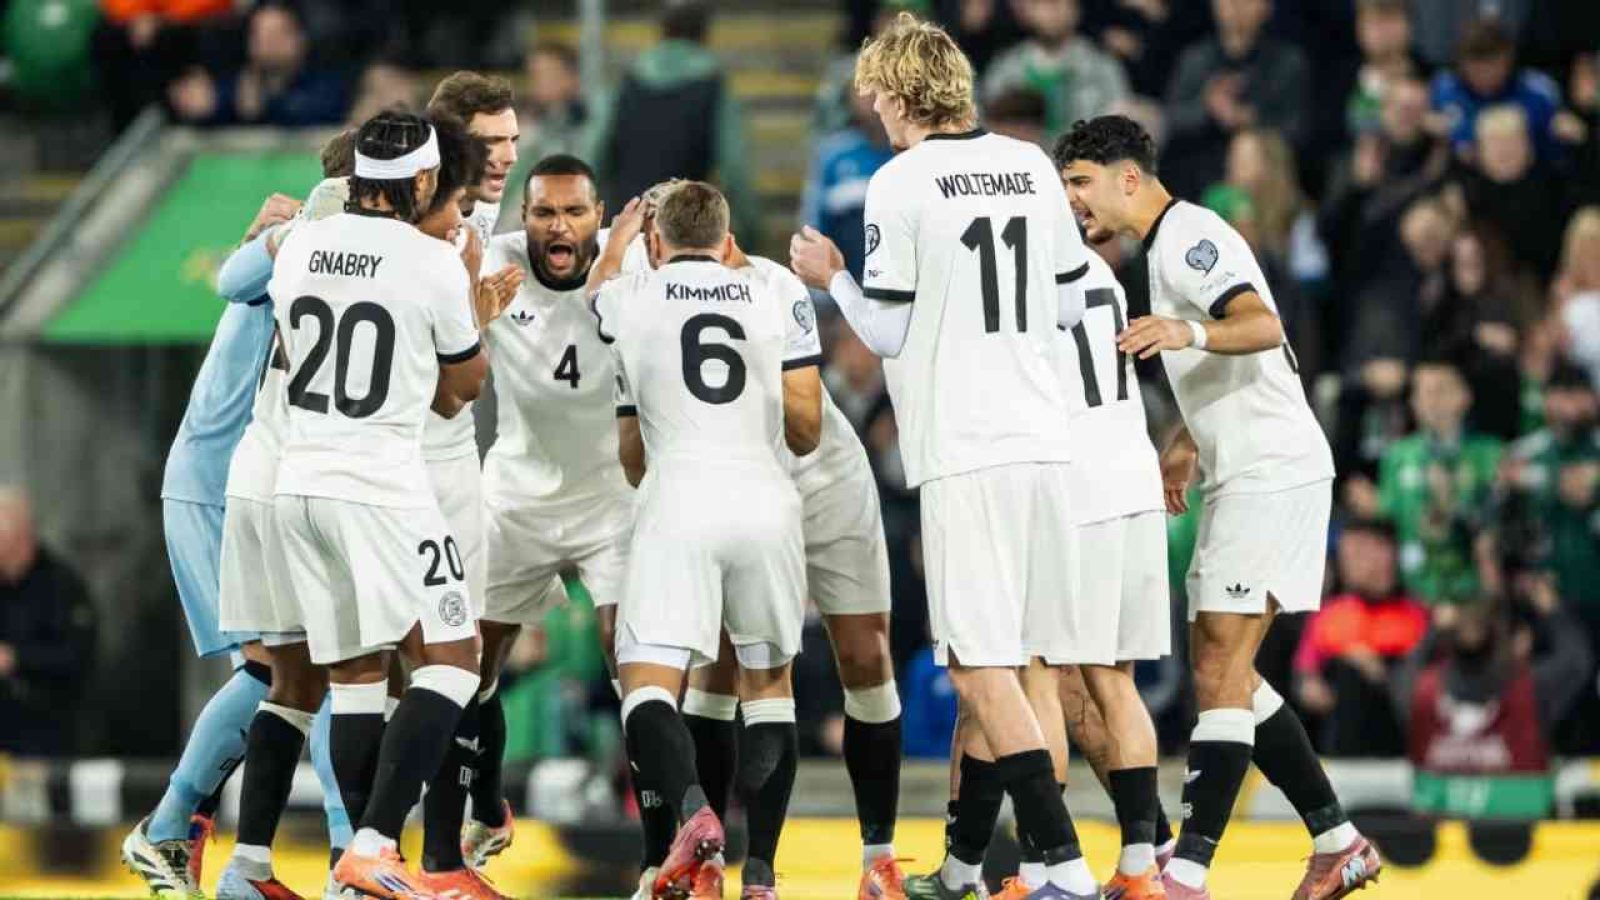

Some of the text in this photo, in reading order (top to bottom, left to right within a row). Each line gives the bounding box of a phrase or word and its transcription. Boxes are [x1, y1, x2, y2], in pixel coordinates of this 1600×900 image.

[935, 173, 1036, 198] WOLTEMADE
[309, 251, 382, 277] GNABRY
[960, 216, 1027, 333] 11
[666, 283, 752, 303] KIMMICH
[288, 296, 395, 418] 20
[554, 344, 581, 389] 4
[681, 313, 746, 405] 6
[1071, 288, 1128, 408] 17
[418, 536, 465, 586] 20
